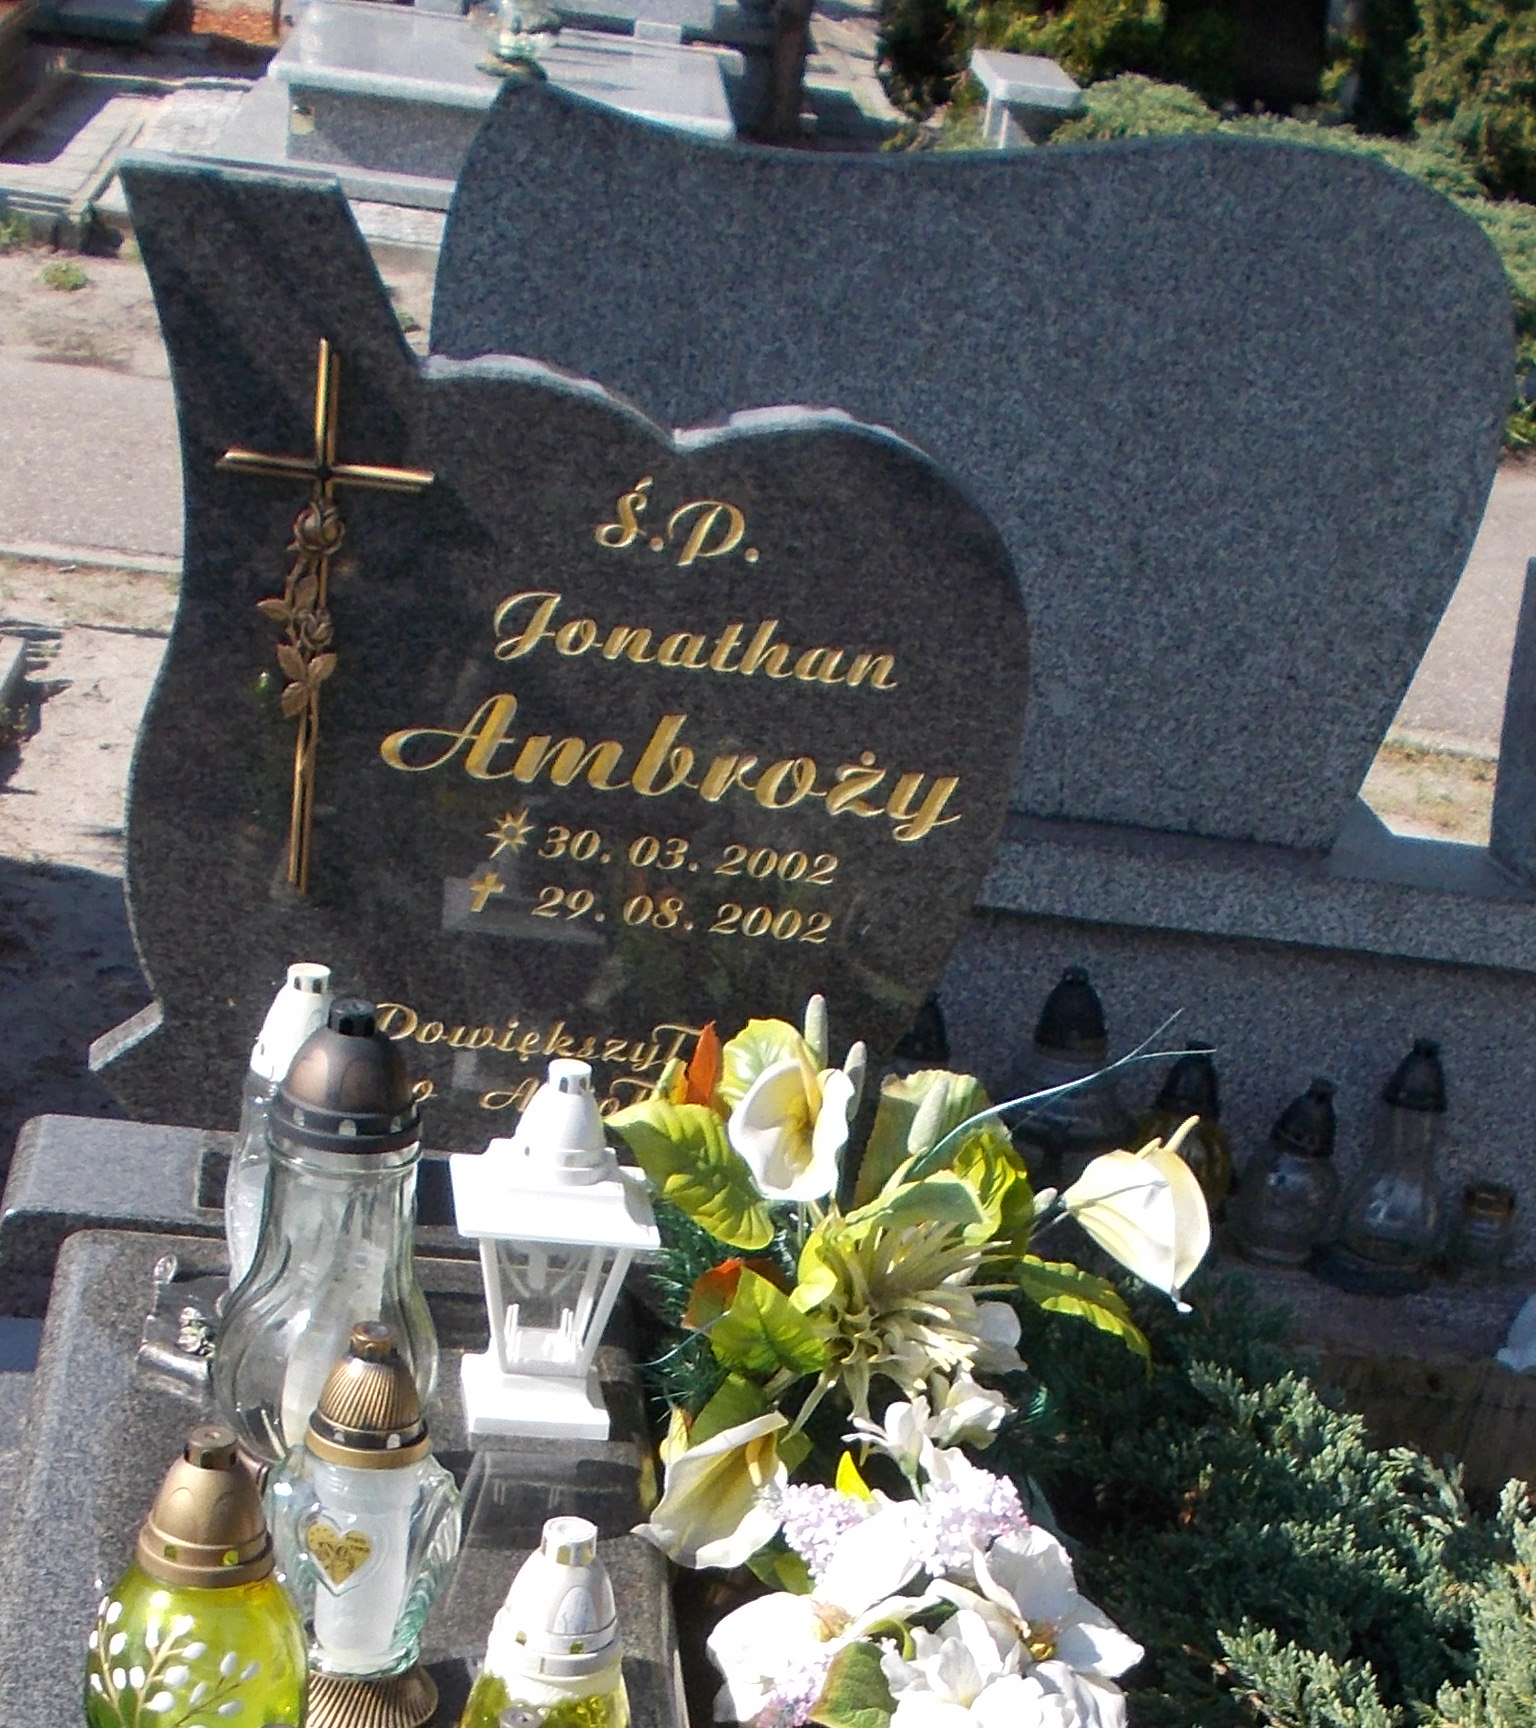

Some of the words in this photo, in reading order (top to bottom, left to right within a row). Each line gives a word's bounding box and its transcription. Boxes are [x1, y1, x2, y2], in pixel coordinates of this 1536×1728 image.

[493, 591, 898, 690] Jonathan
[379, 693, 962, 843] Ambroży
[537, 825, 611, 863] 30.
[628, 835, 700, 873] 03.
[714, 844, 839, 885] 2002
[530, 886, 606, 922] 29.
[622, 894, 694, 931] 08.
[707, 903, 834, 944] 2002
